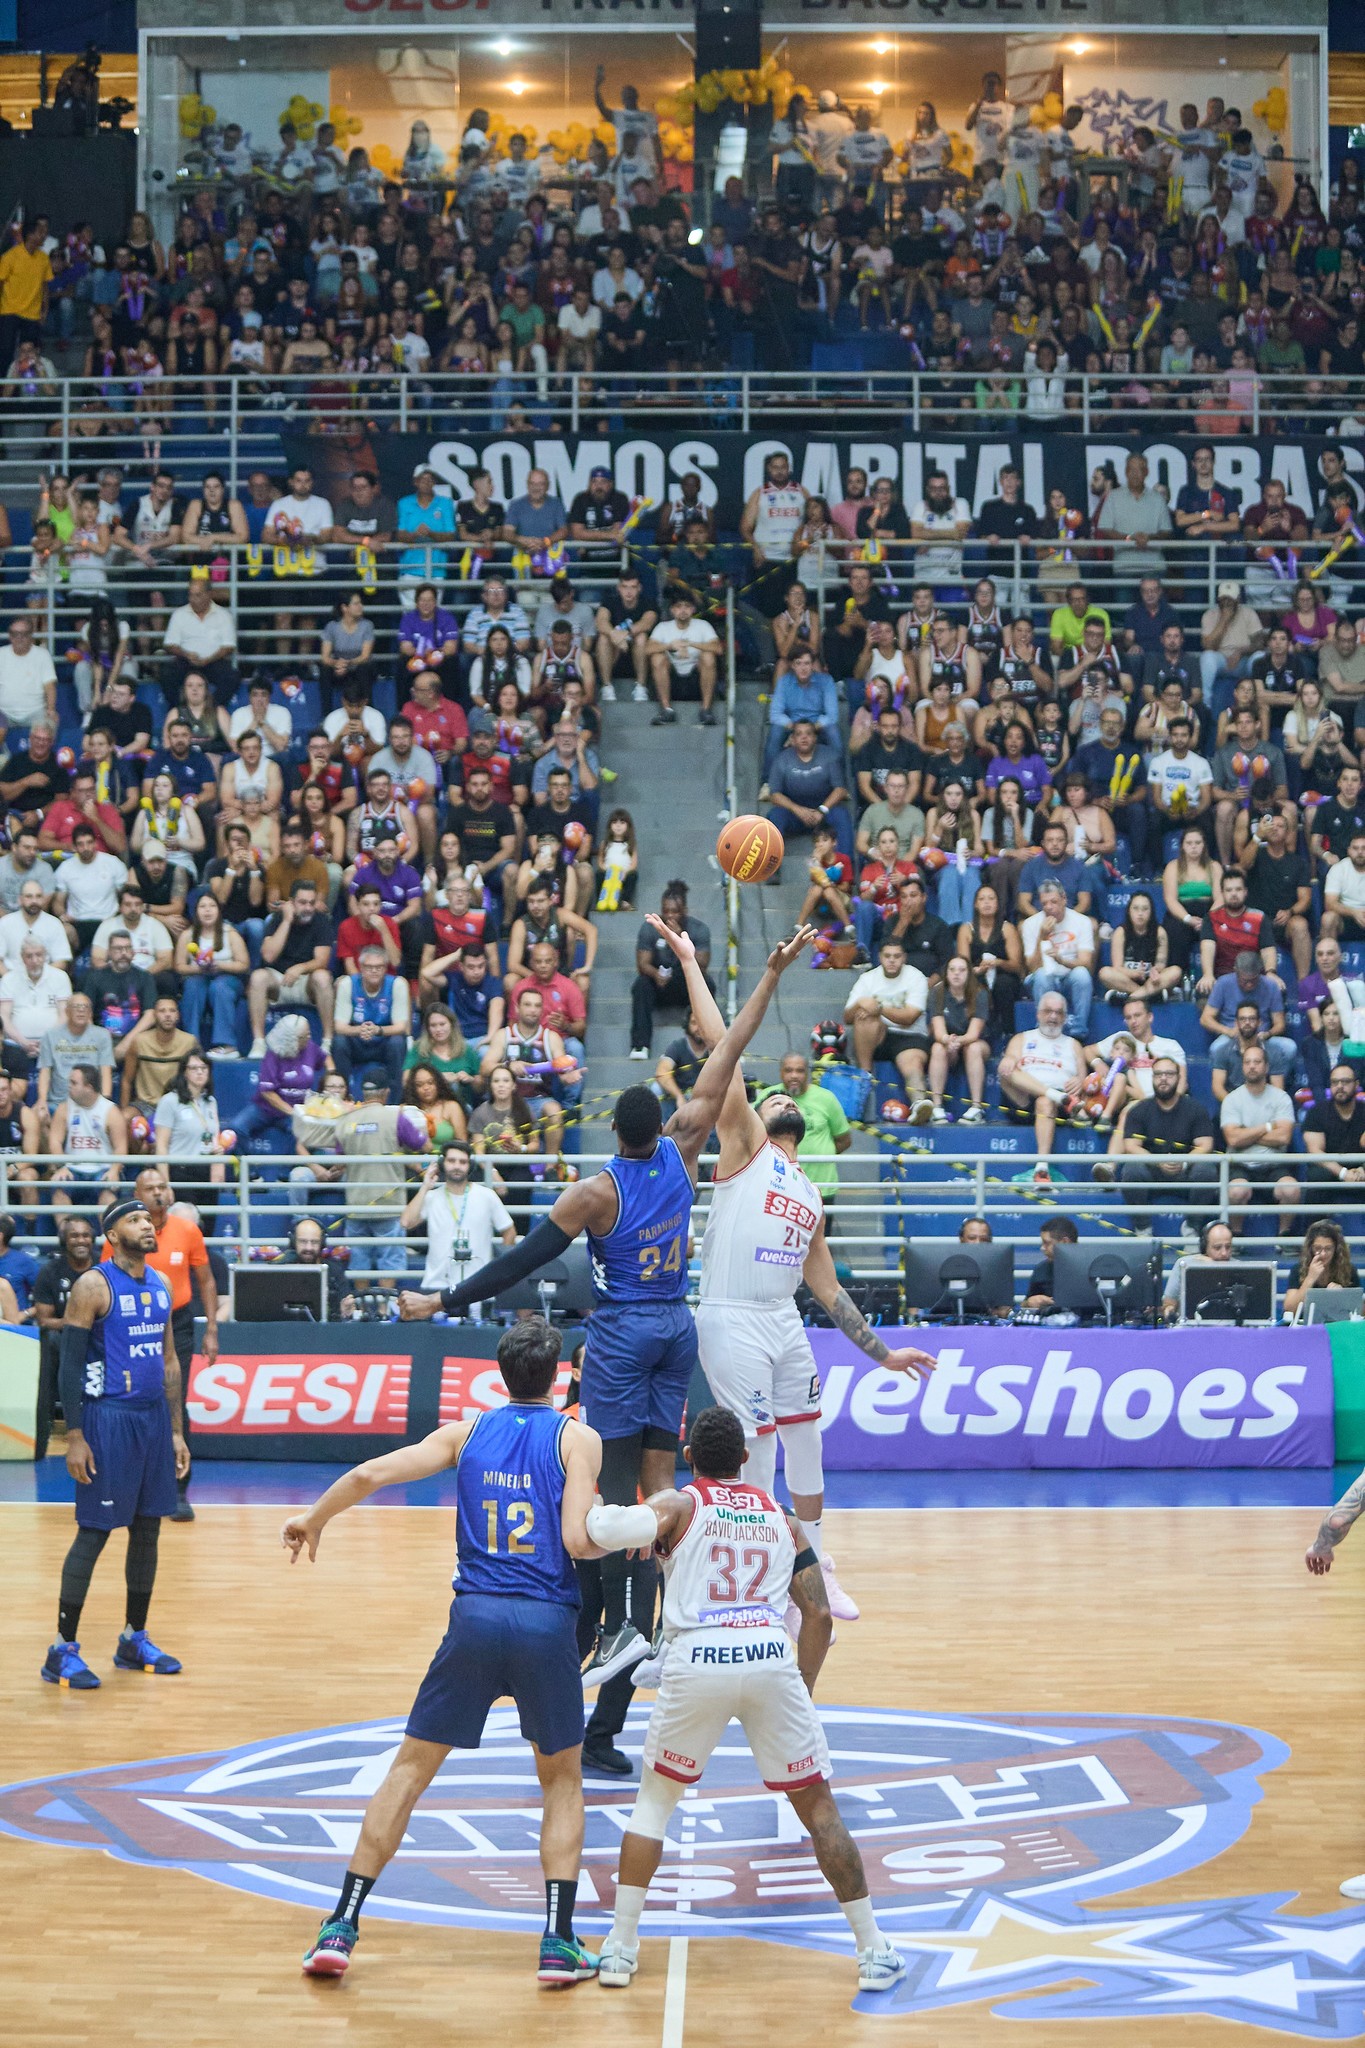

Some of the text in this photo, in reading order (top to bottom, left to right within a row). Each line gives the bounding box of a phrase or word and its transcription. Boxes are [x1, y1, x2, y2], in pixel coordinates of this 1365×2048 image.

[427, 439, 720, 514] SOMOS
[736, 834, 764, 880] PENALTY
[990, 1138, 1018, 1150] 602
[638, 1212, 683, 1241] PARANHOS
[770, 1195, 816, 1230] SESI
[638, 1235, 681, 1281] 24
[128, 1321, 165, 1336] minas
[122, 1370, 132, 1393] 1
[188, 1363, 389, 1425] SESI
[482, 1499, 536, 1555] 12
[704, 1521, 779, 1544] DAVID JACKSON
[707, 1542, 771, 1604] 32
[691, 1641, 785, 1664] FREEWAY
[665, 1751, 694, 1768] FIESP
[790, 1757, 812, 1772] SESI
